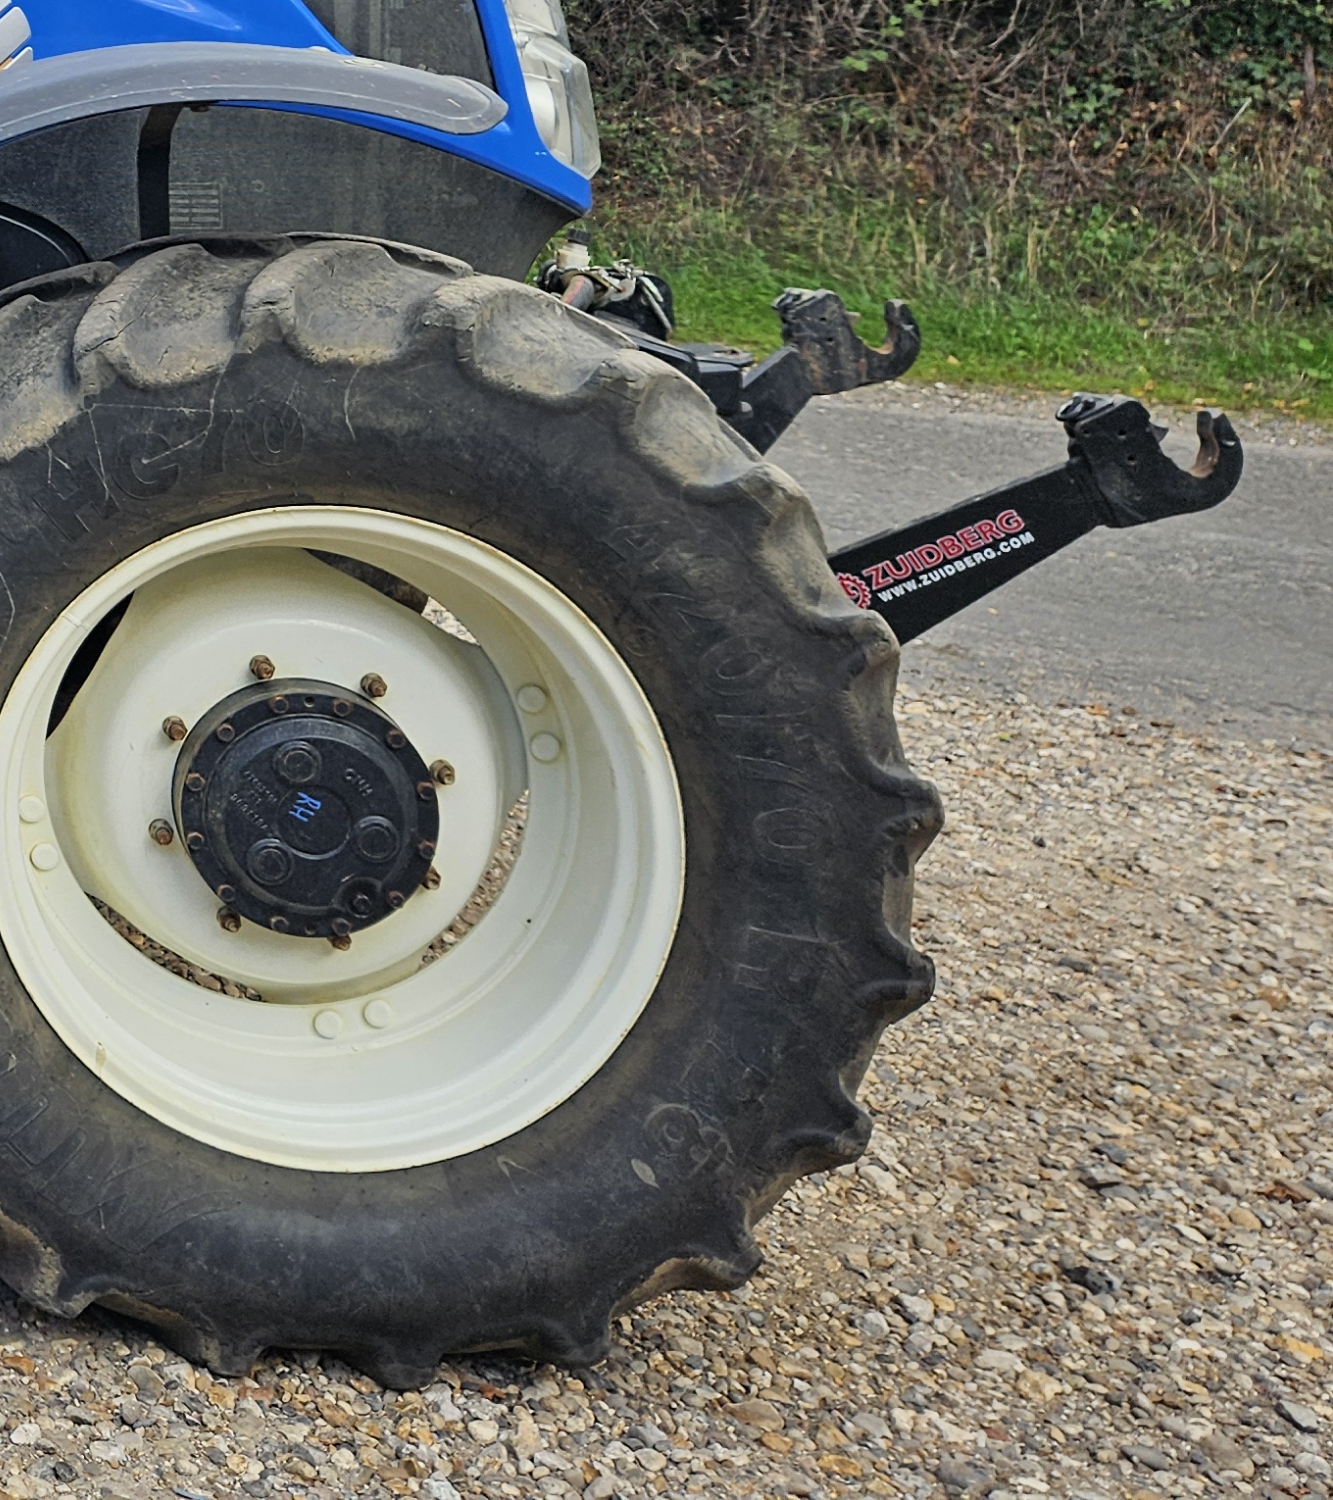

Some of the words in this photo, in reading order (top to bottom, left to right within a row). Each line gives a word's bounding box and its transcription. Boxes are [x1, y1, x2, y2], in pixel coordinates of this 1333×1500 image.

[862, 509, 1025, 590] ZUIDBERG
[876, 531, 1036, 603] WWW.ZUIDBERG.COM
[288, 791, 322, 823] RH
